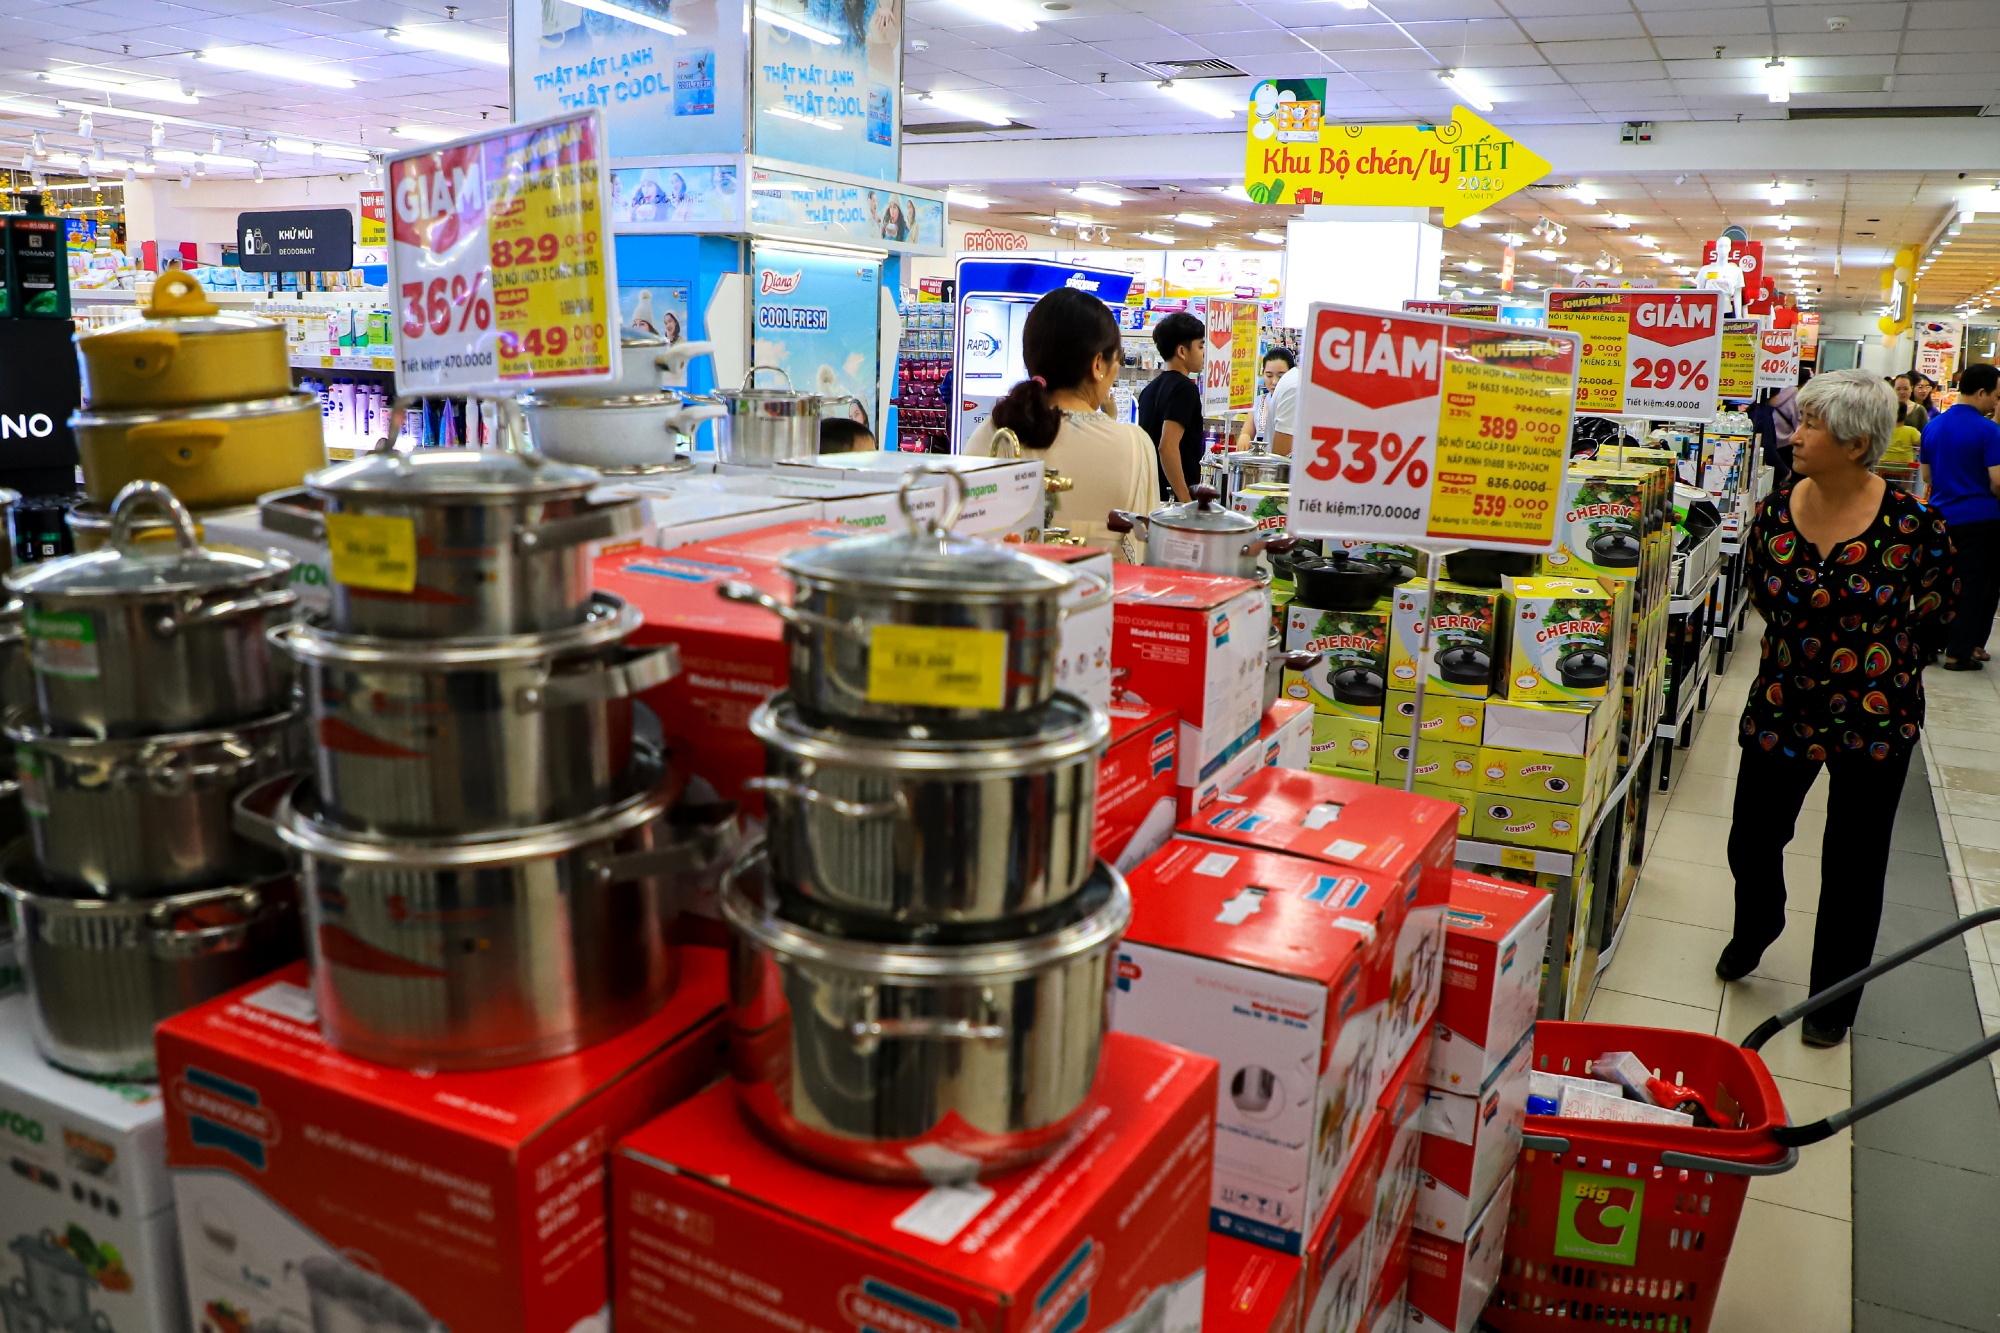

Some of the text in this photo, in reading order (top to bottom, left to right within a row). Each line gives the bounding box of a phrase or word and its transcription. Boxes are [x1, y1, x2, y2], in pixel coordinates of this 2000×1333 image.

[534, 47, 654, 93] THẬT MÁT LẠNH
[763, 63, 855, 93] THẬT MÁT LẠNH
[614, 73, 671, 103] COOL
[828, 97, 865, 118] COOL
[1264, 135, 1514, 183] Khu Bộ chén/ly TẾT
[1457, 176, 1504, 191] 2020
[816, 186, 833, 201] MÁT
[835, 188, 858, 207] LẠNH
[806, 206, 866, 231] THẬT COOL
[279, 226, 313, 240] KHỬ MÙI
[966, 229, 1014, 250] PHÒNG
[19, 250, 54, 258] ROMANO
[492, 233, 559, 268] 829
[1709, 250, 1741, 260] SLE
[761, 270, 801, 293] Diana
[402, 272, 491, 339] 36%
[1563, 295, 1601, 309] KHUYẾN
[1636, 295, 1712, 328] GIẢM
[759, 306, 827, 330] COOL FRESH
[1210, 303, 1232, 333] GIẢM
[500, 326, 568, 359] 849
[967, 339, 990, 350] RAPID
[1764, 331, 1791, 347] GIẢM
[1232, 348, 1246, 359] 499
[1319, 319, 1439, 381] GIẢM
[402, 358, 419, 373] Tiết
[1207, 360, 1230, 388] 20%
[1630, 358, 1709, 391] 29%
[1761, 359, 1789, 374] 40%
[1502, 371, 1517, 379] KIM
[1519, 371, 1543, 383] NHÔM
[1230, 385, 1245, 396] 359
[1467, 382, 1551, 399] SH 6633 16+20+24CM
[1627, 398, 1700, 409] Tiết kiệm:49.000đ
[1479, 415, 1518, 440] 389
[1305, 426, 1428, 488] 33%
[1465, 439, 1481, 450] CAO
[1500, 443, 1504, 452] 3
[1523, 446, 1540, 456] QUAI
[1542, 449, 1562, 458] CONG
[1507, 460, 1549, 473] 16+20+24CM
[1440, 486, 1473, 495] 28%
[1486, 476, 1547, 492] 836.000đ
[1299, 499, 1421, 520] Tiết kiệm:170.000đ
[1472, 493, 1506, 518] 539
[1566, 504, 1633, 522] CHERRY
[1132, 617, 1191, 631] COOKWARE SET
[1414, 615, 1484, 634] CHERRY
[1536, 621, 1602, 643] CHERRY
[1130, 628, 1191, 642] Model: SH6633
[1306, 634, 1377, 653] CHERRY
[1420, 718, 1443, 729] CHER
[1520, 764, 1553, 776] CHERRY
[1504, 822, 1536, 833] CHERRY
[1575, 1182, 1610, 1204] Big
[1574, 1186, 1636, 1247] C
[1564, 1245, 1627, 1259] SUPERCENTER
